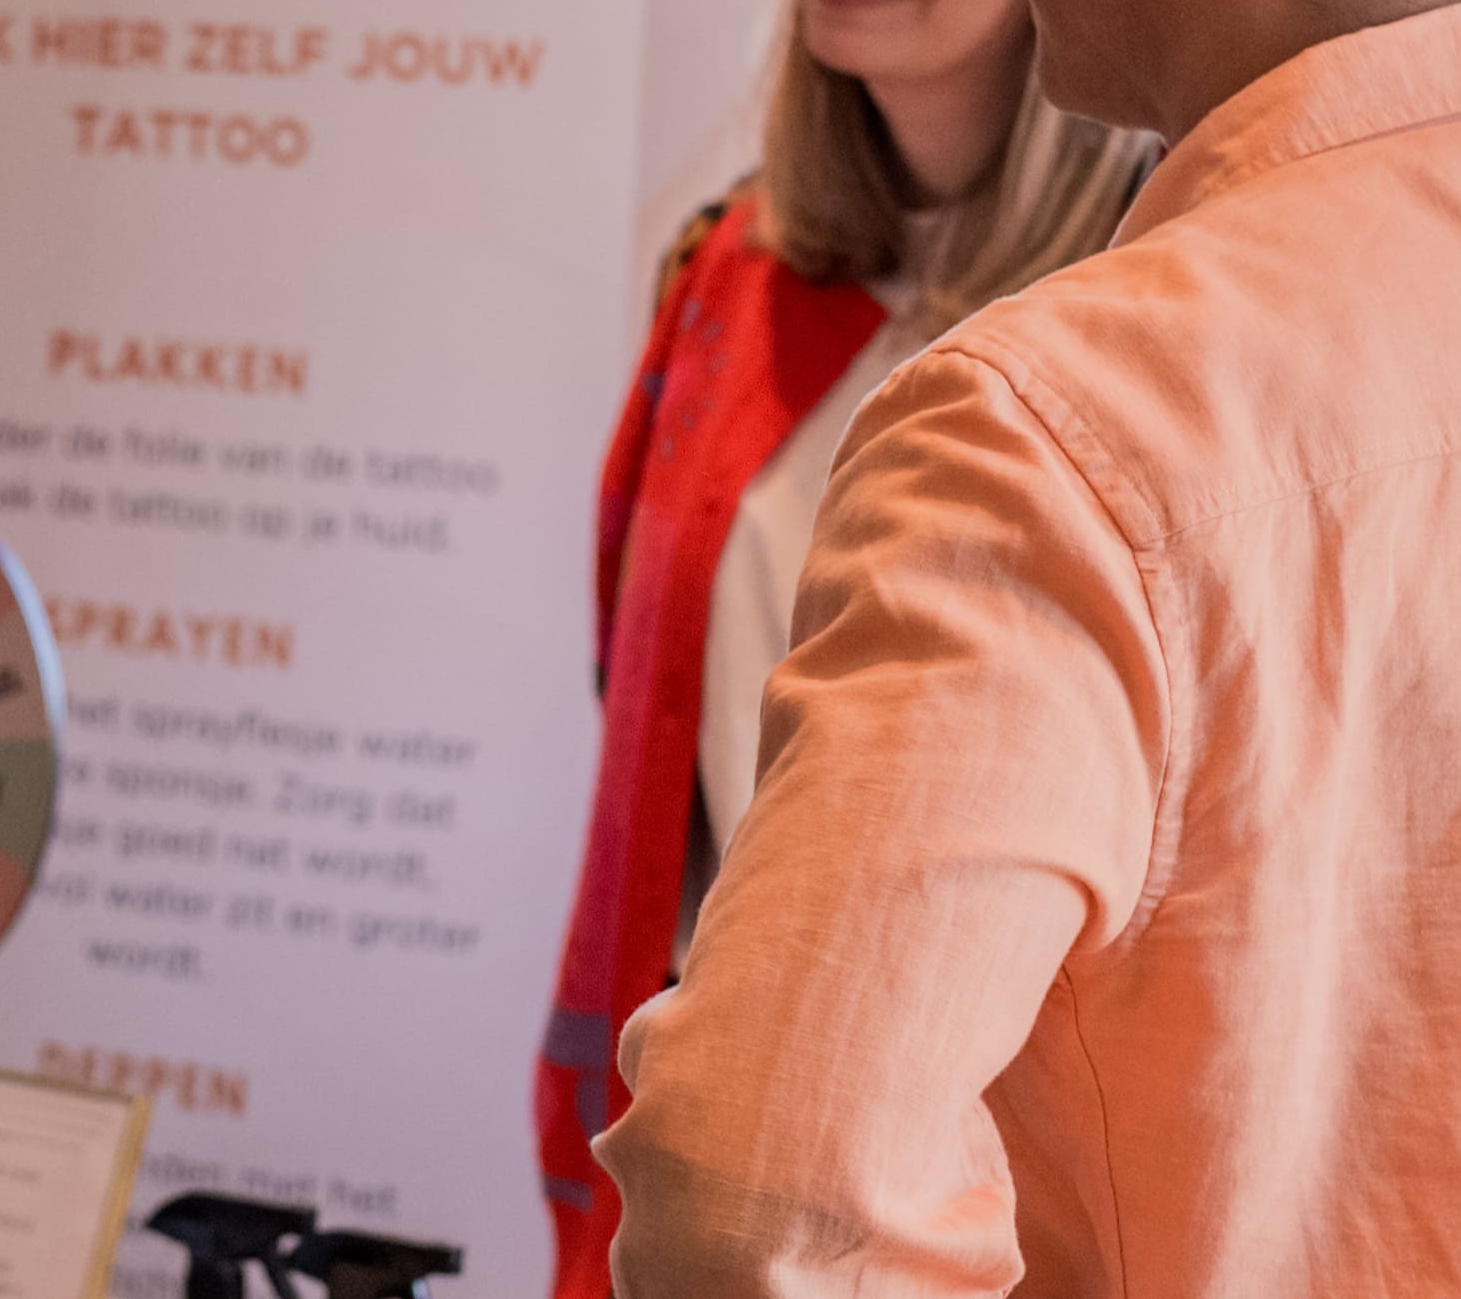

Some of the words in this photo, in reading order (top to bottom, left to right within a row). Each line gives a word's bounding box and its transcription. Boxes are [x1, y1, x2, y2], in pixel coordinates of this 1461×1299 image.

[29, 16, 166, 70] HIER
[181, 19, 327, 77] ZELF
[344, 30, 543, 87] JOUW
[70, 104, 308, 166] TATTOO
[46, 328, 307, 394] PLAKKEN
[63, 424, 110, 460] de
[121, 426, 206, 468] folie
[216, 444, 290, 476] van
[297, 445, 355, 482] de
[365, 448, 499, 498] tattoo
[49, 484, 97, 519] de
[110, 489, 227, 530] tattoo
[233, 505, 292, 541] op
[49, 597, 294, 670] SPRAYEN
[355, 731, 476, 769] water
[274, 772, 376, 829] Zorg
[391, 794, 455, 830] dat
[118, 822, 216, 863] goed
[101, 882, 211, 919] water
[282, 906, 334, 936] en
[351, 913, 481, 953] groter
[39, 1042, 248, 1114] DEPPEN
